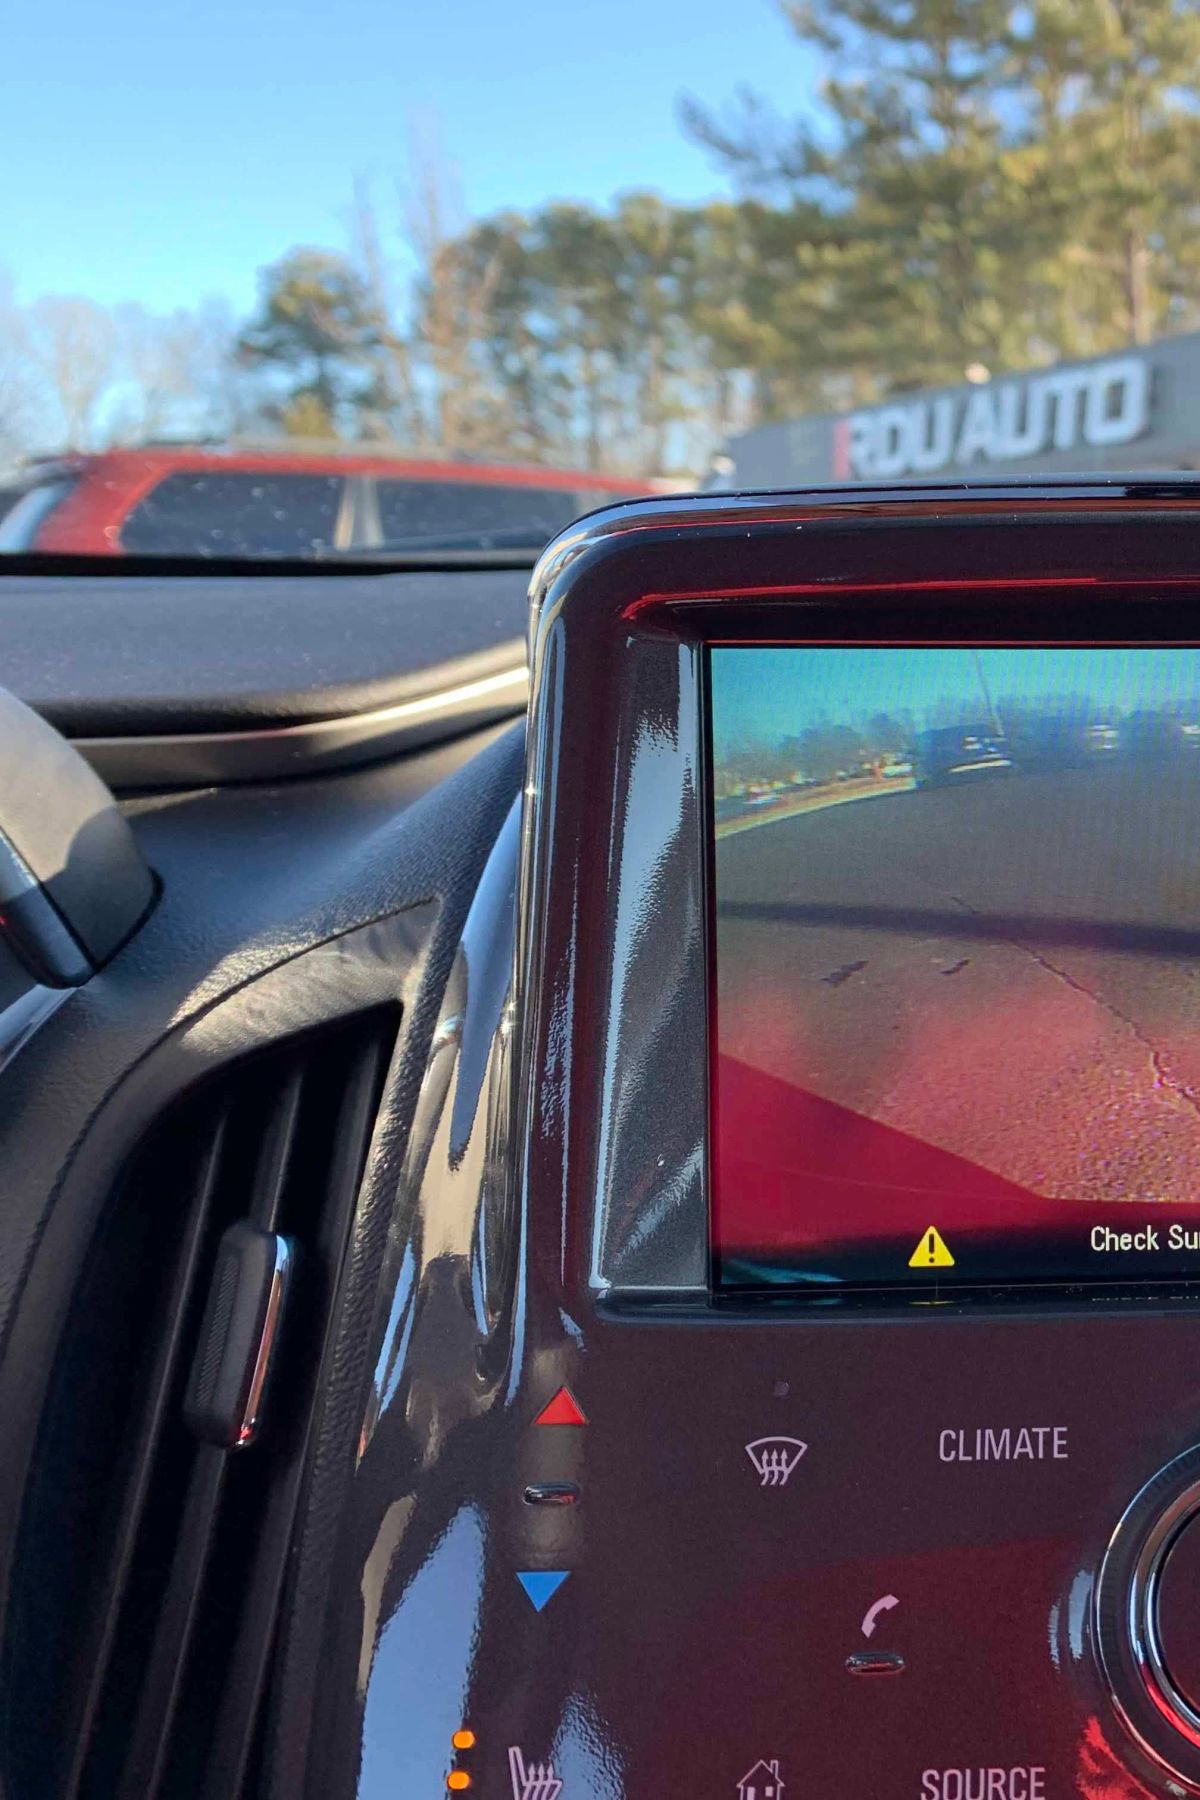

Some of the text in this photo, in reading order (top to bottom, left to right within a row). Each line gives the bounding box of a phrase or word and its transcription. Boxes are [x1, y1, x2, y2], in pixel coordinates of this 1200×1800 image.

[1090, 1225, 1160, 1251] Check
[939, 1427, 1068, 1462] CLIMATE
[921, 1767, 1046, 1800] SOURCE
